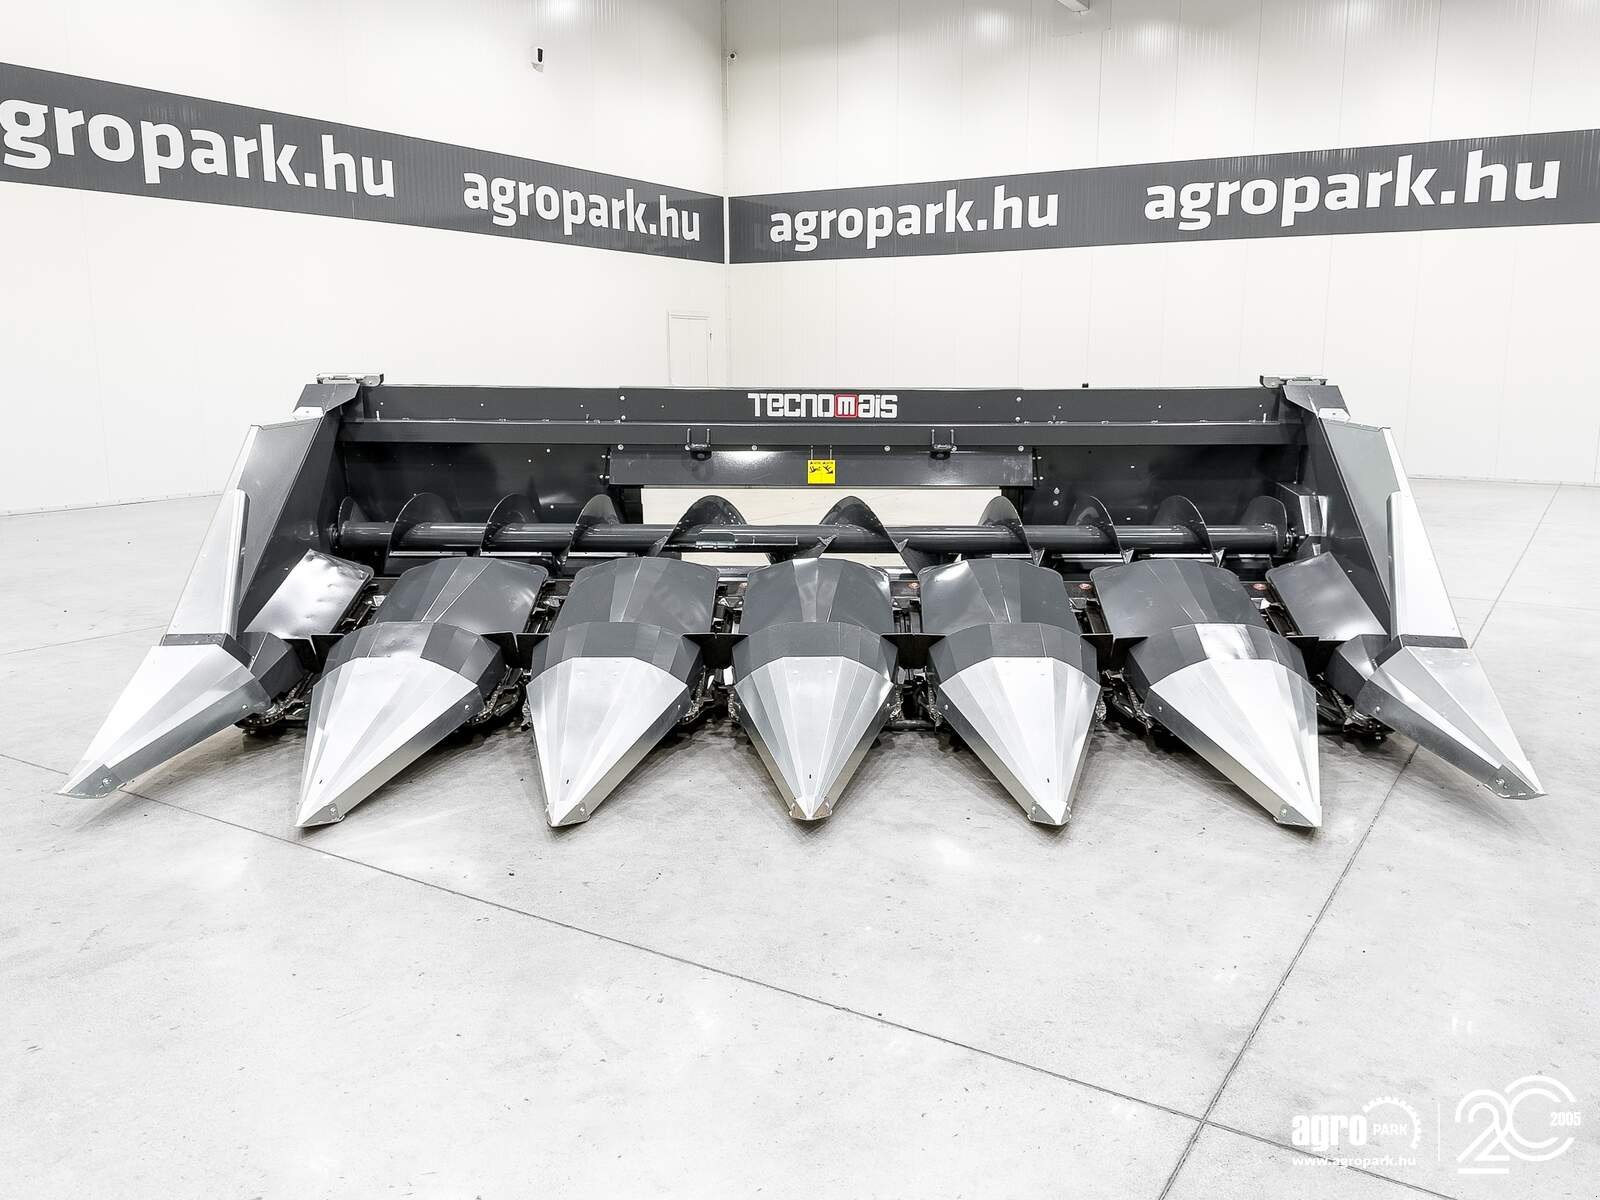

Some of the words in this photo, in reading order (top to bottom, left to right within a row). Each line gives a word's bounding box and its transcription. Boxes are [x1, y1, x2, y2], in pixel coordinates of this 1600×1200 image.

[463, 172, 700, 242] agropark.hu
[769, 184, 1059, 252] agropark.hu
[1143, 149, 1561, 231] agropark.hu
